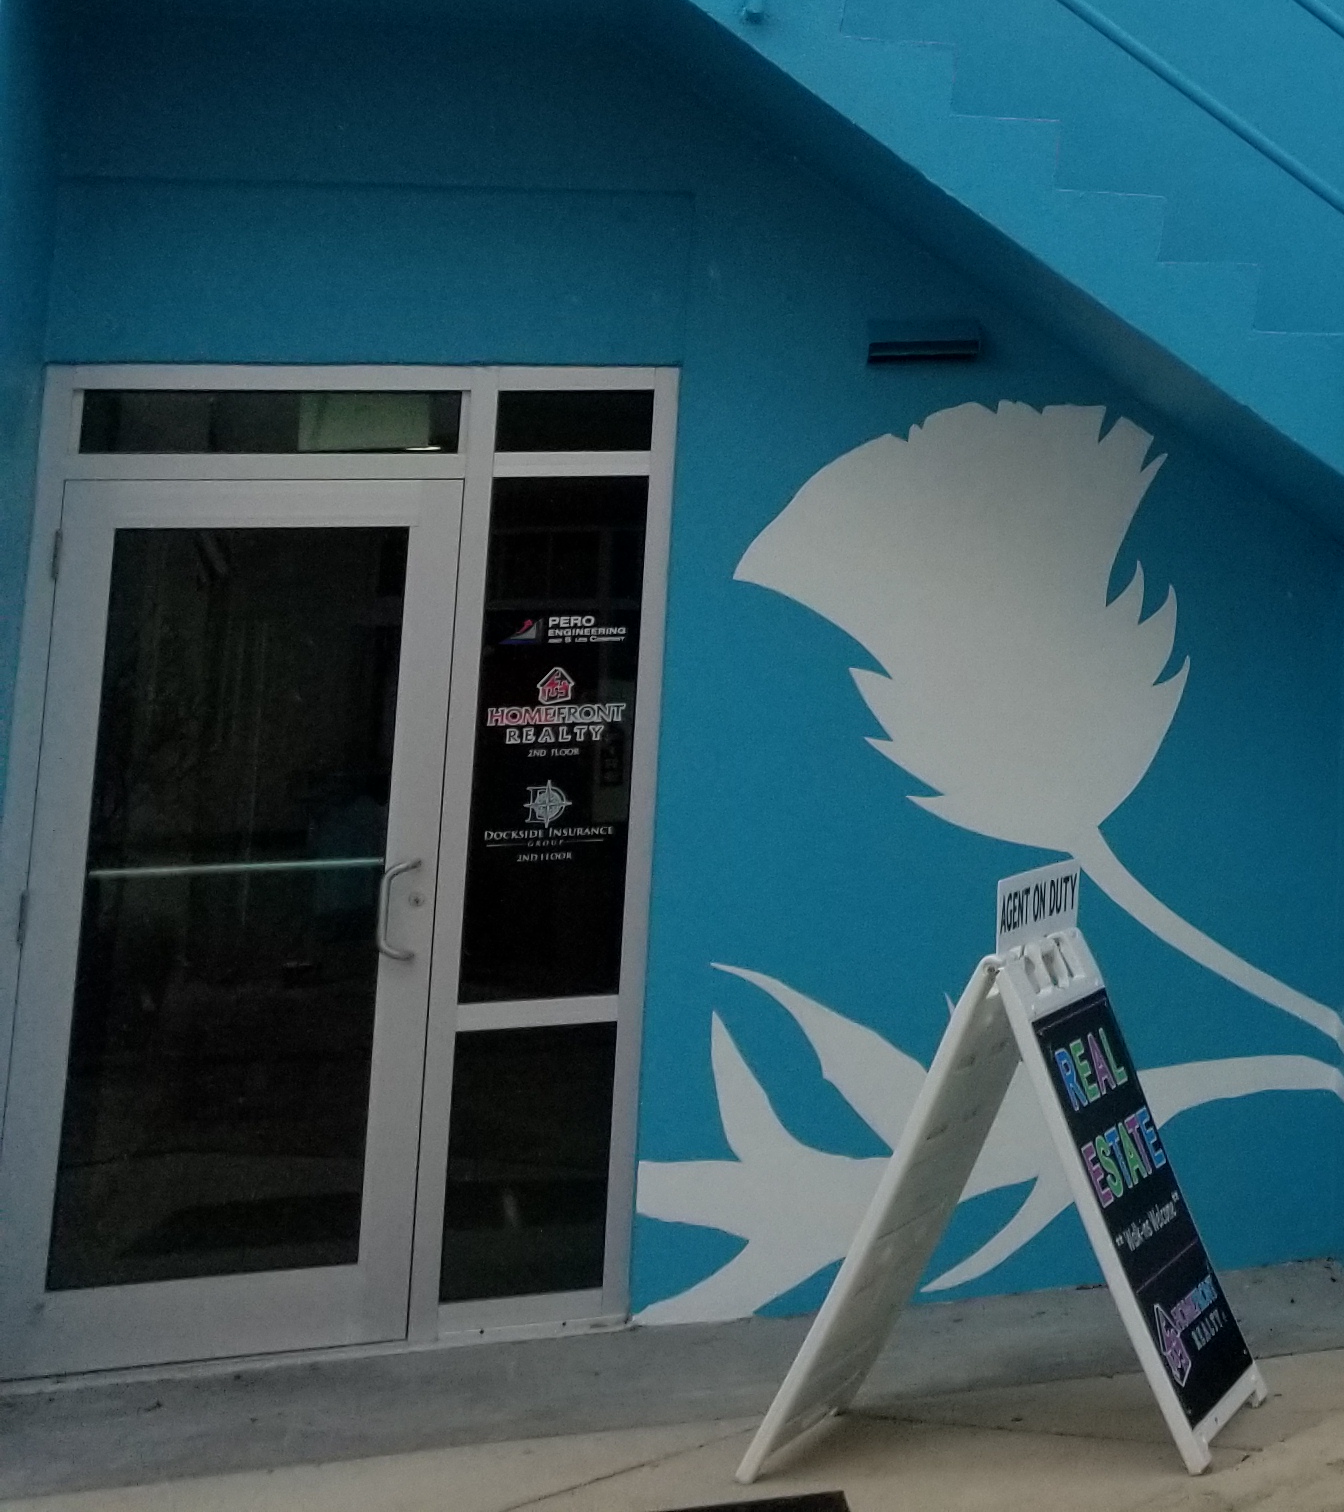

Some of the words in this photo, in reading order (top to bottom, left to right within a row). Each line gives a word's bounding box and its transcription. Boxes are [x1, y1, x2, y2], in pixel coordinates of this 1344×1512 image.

[547, 627, 626, 637] ENGINEERING
[548, 615, 595, 628] PERO
[486, 703, 626, 726] HOMEFRONT
[505, 725, 604, 744] REALTY
[484, 830, 544, 841] DOCKSIDE
[549, 826, 614, 838] INSURANCE
[1000, 886, 1030, 935] AGENT
[1033, 882, 1046, 922] ON
[1049, 872, 1077, 916] DUTY
[1054, 1027, 1128, 1111] REAL
[1081, 1106, 1167, 1209] ESTATE
